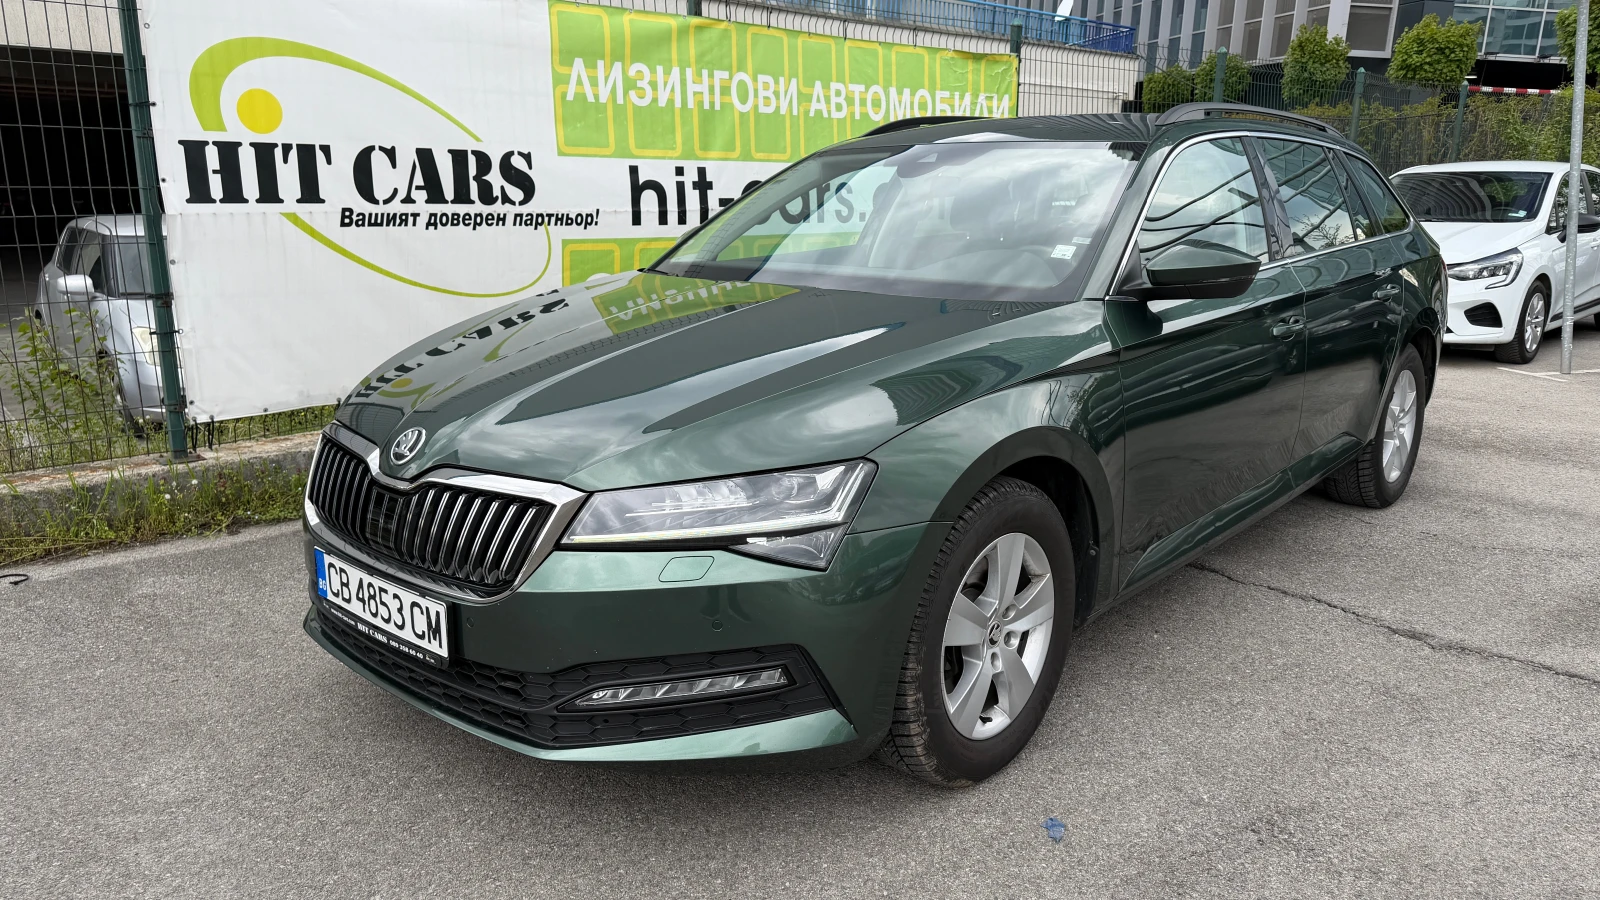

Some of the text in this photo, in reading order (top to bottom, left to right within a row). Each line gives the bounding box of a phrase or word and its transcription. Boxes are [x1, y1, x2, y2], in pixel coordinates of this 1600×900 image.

[566, 57, 1010, 122] ЛИЗИНГОВИ АВТОМОБИЛИ
[178, 139, 536, 206] HIT CARS
[340, 207, 600, 231] Вашият доверен партньор!
[318, 577, 327, 591] BG
[327, 561, 443, 650] CB 4853 CM
[357, 622, 388, 644] HIT CARS
